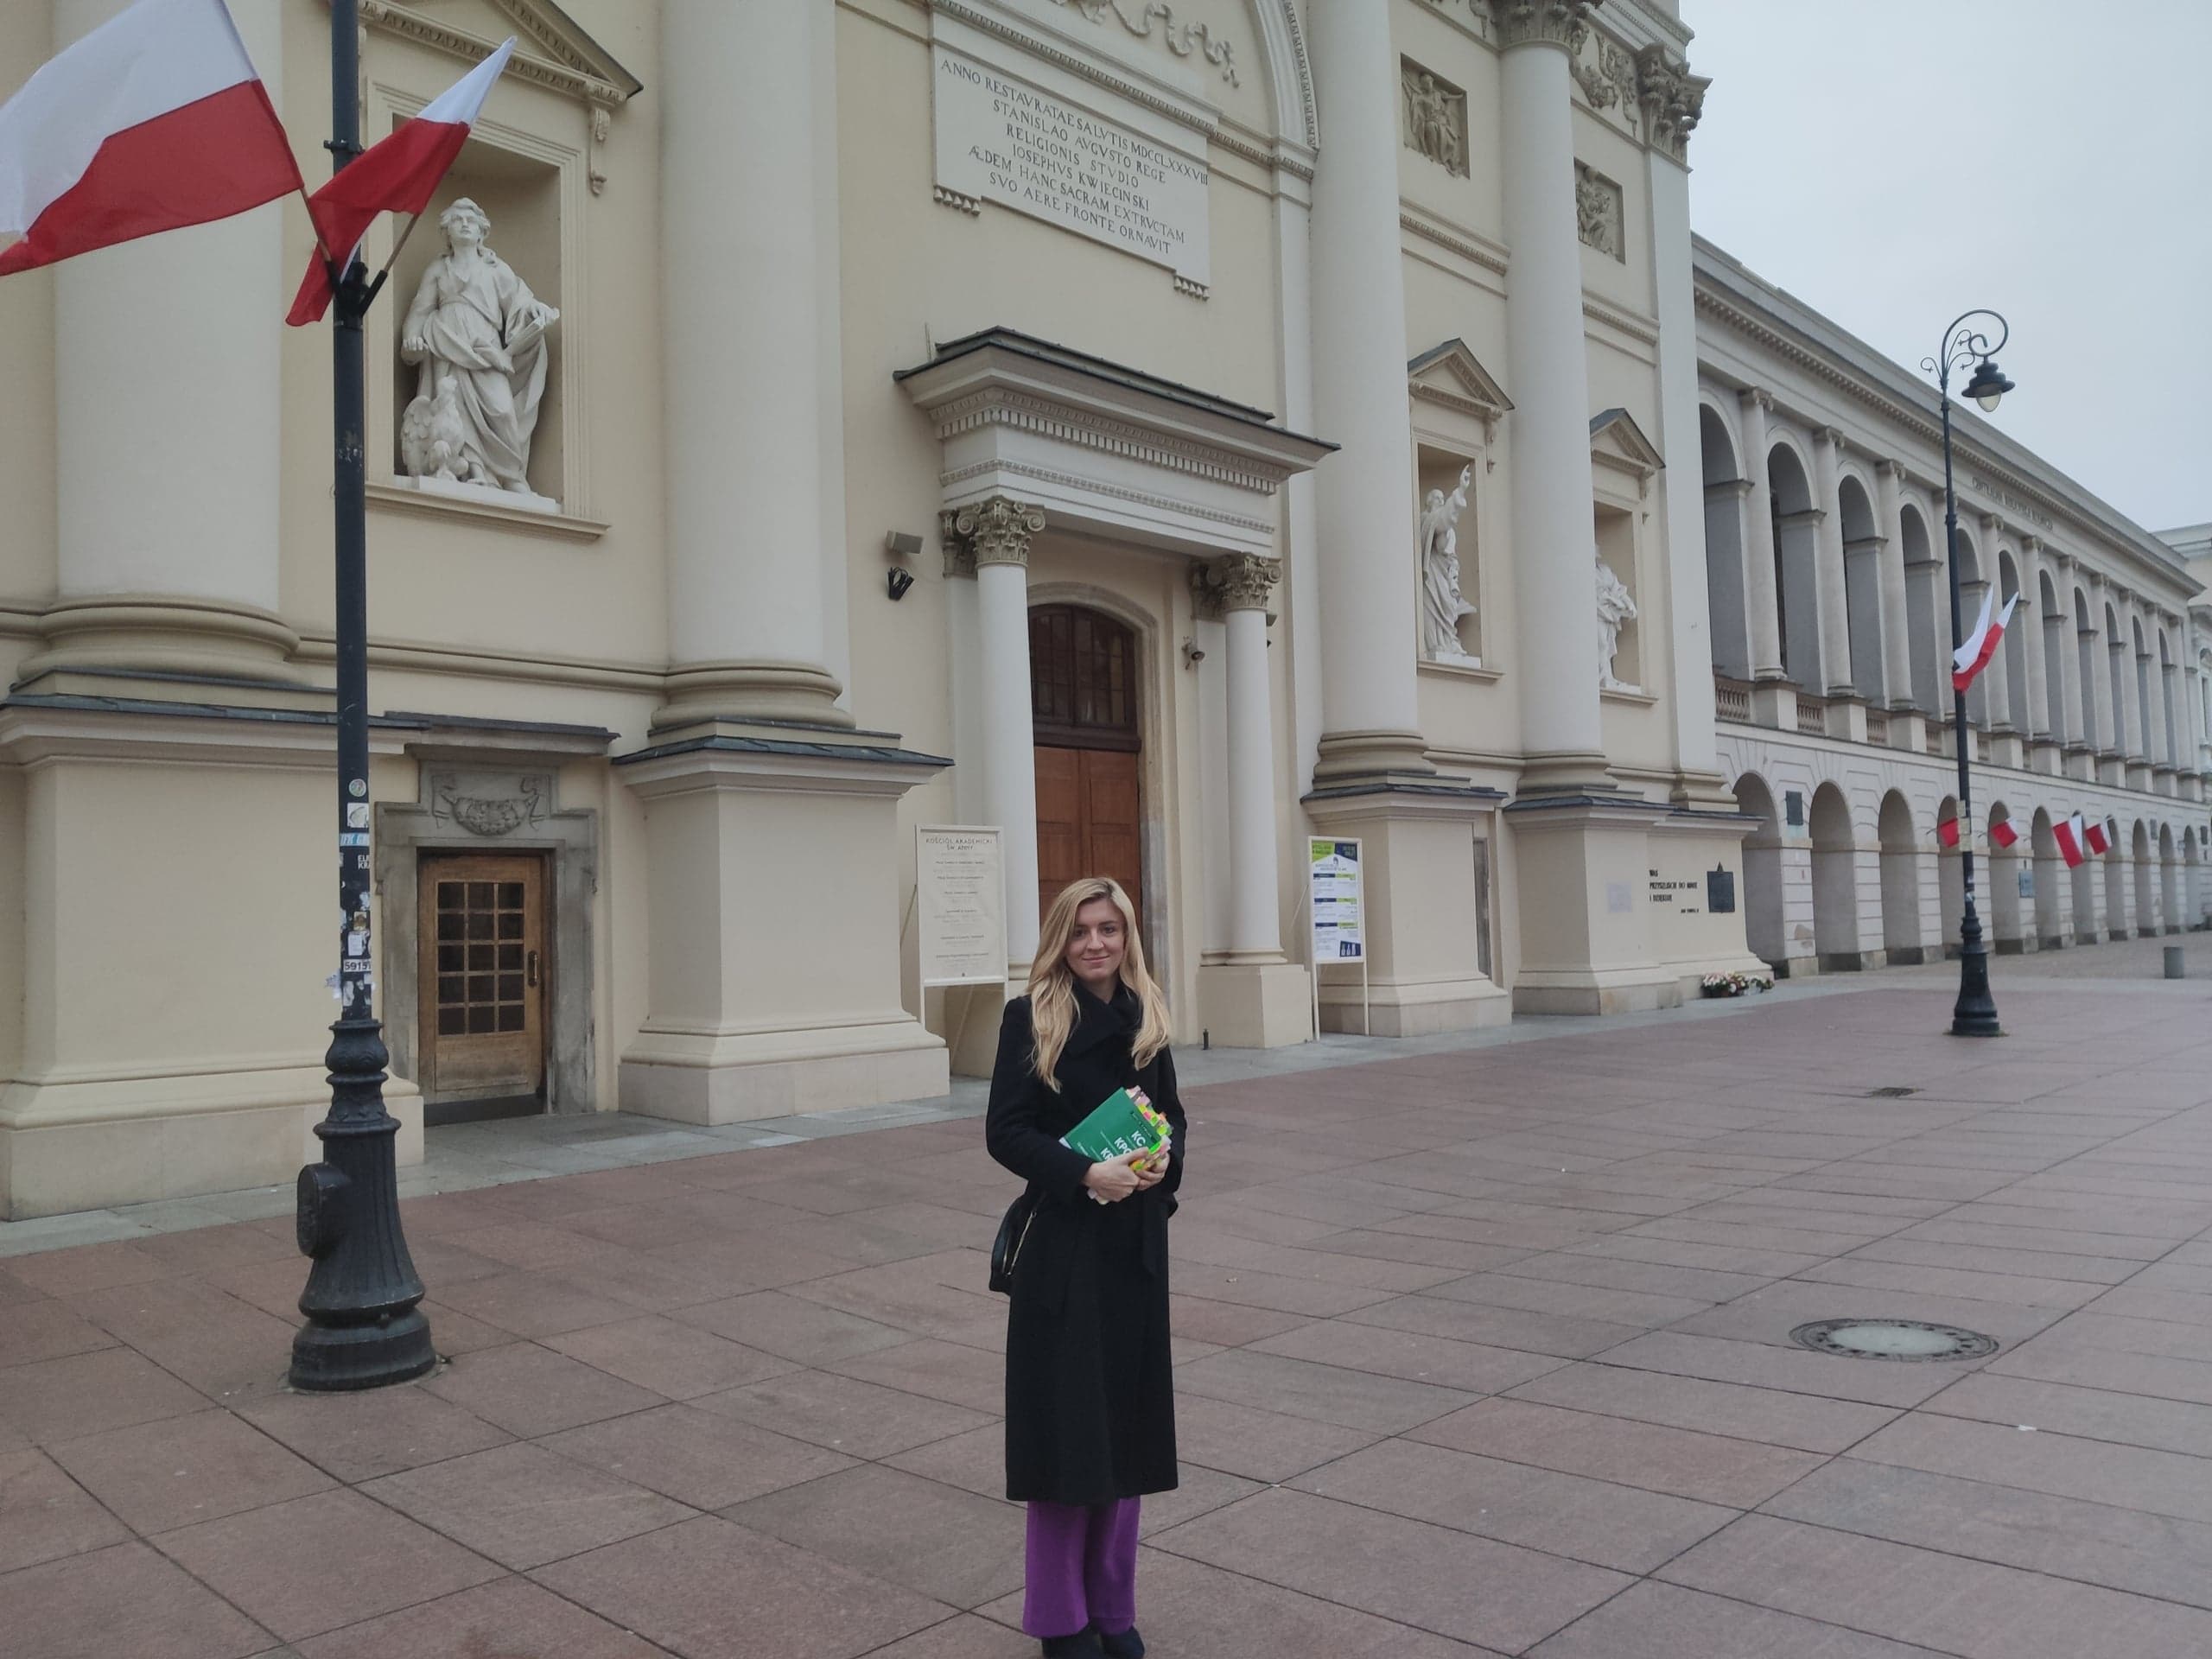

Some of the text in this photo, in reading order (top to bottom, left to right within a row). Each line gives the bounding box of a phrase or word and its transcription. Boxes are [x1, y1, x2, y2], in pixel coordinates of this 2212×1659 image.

[941, 60, 1208, 186] ANNO RESTAVRATAE SALVTIS MDCCLXXXVIII
[994, 99, 1166, 183] STANISLAO AVGVSTO REGE
[1007, 124, 1139, 188] RELIGIONIS STVDIO
[989, 172, 1171, 254] SVO AERE FRONTE ORNAVIT
[1013, 143, 1149, 212] IOSEPHVS KWIECINSKI
[1020, 165, 1058, 190] HANC
[1060, 182, 1109, 213] SACRAM
[1115, 205, 1185, 244] EXTRVCTAM
[1131, 1130, 1146, 1147] KC
